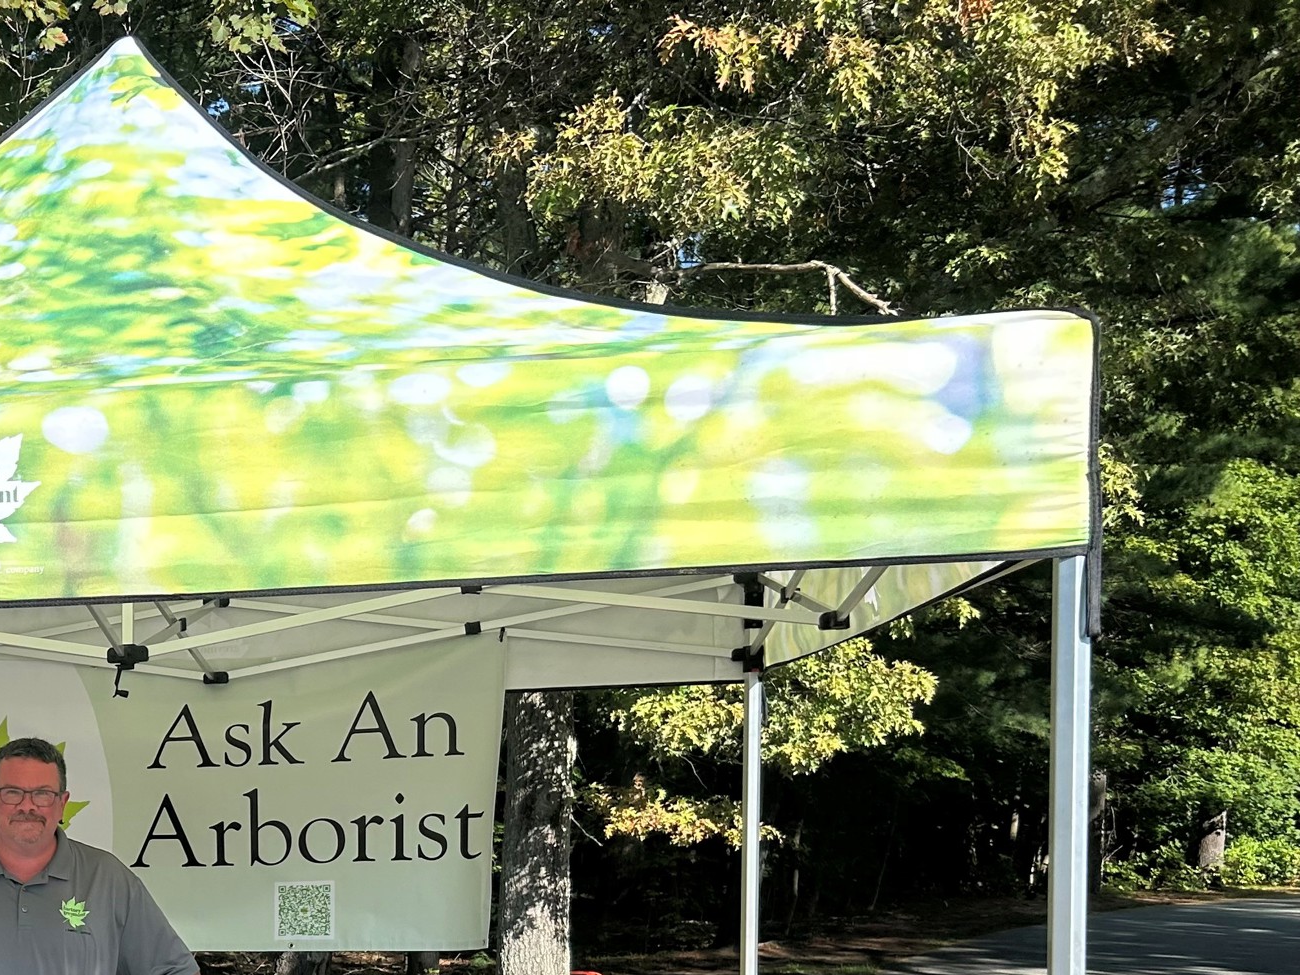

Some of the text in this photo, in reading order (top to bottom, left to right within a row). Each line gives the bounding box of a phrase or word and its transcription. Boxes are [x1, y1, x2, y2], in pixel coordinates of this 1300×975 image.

[5, 565, 45, 576] company
[146, 690, 465, 769] Ask An
[129, 787, 485, 869] Arborist
